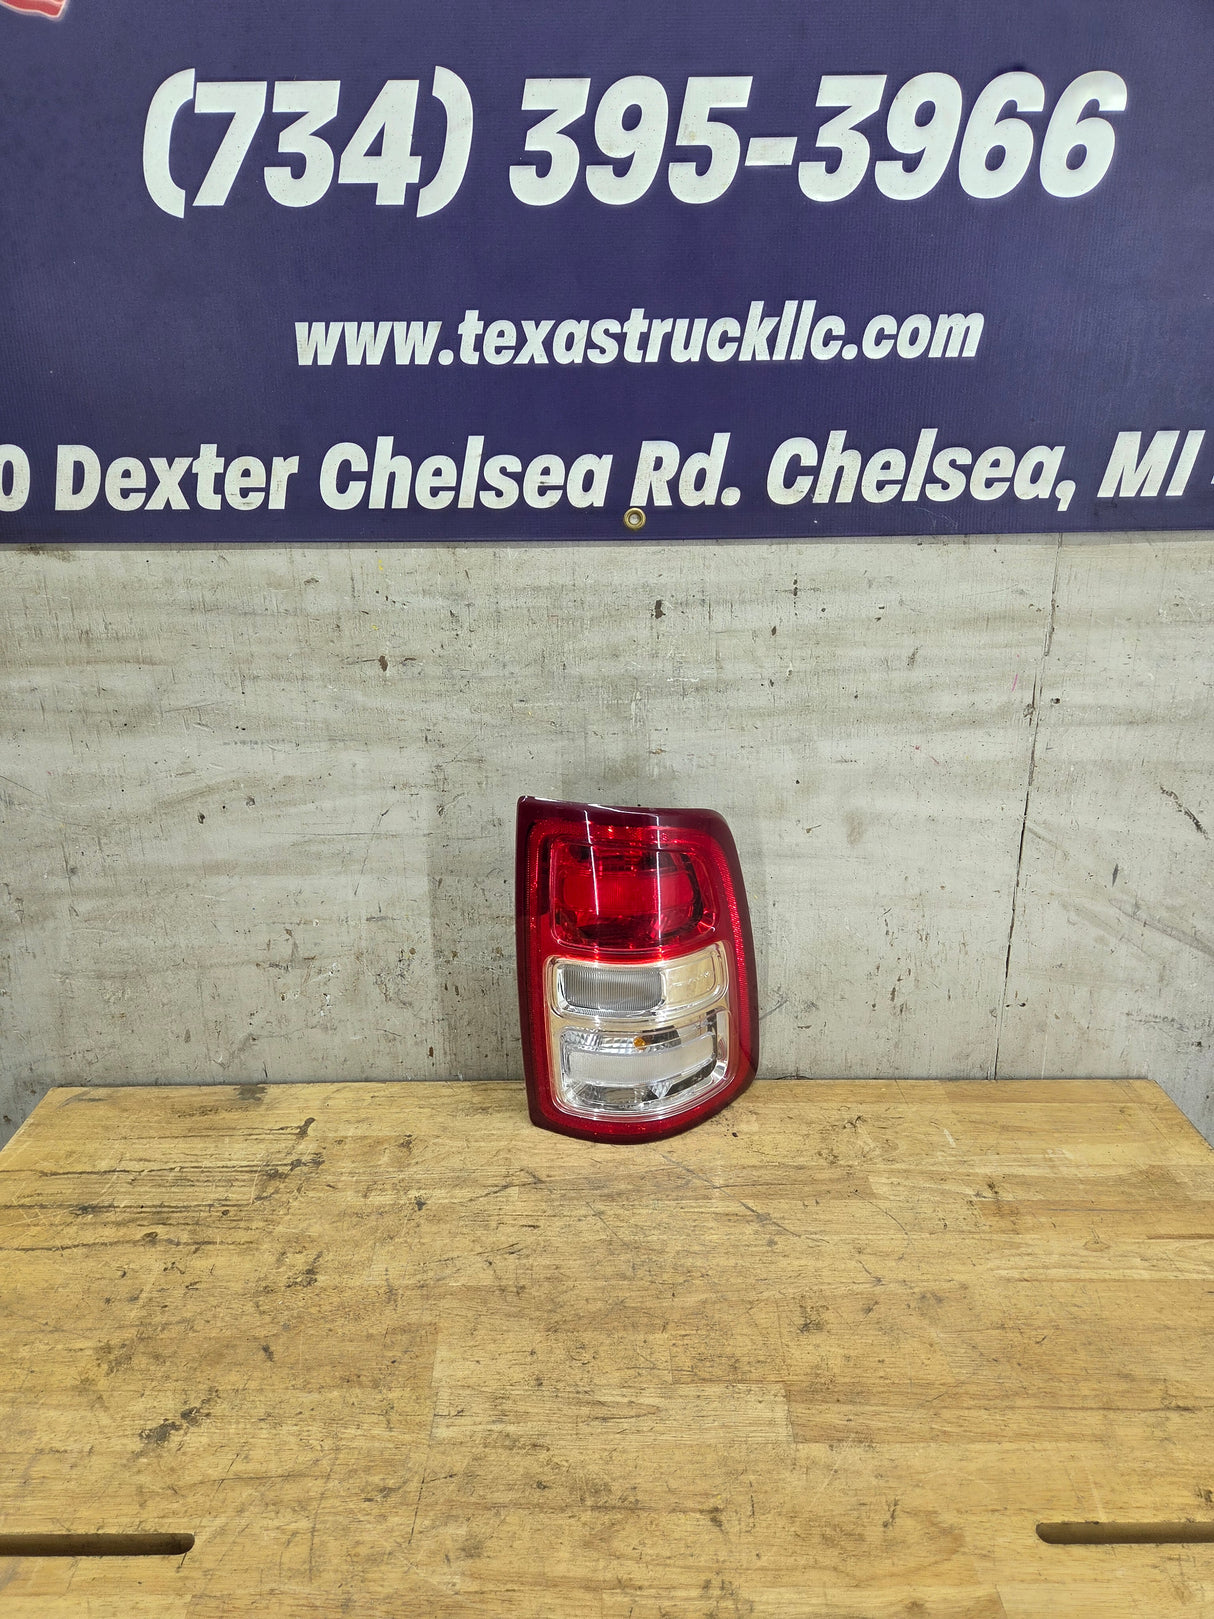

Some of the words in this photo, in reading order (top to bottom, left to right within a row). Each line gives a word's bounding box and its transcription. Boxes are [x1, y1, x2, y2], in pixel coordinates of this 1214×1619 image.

[143, 66, 474, 218] (734)
[509, 71, 1128, 206] 395-3966
[295, 300, 984, 366] www.texastruckllc.com
[54, 444, 299, 511] Dexter
[319, 436, 613, 510] Chelsea
[629, 433, 741, 507] Rd.
[766, 428, 1076, 512] Chelsea,
[1097, 430, 1206, 498] MI
